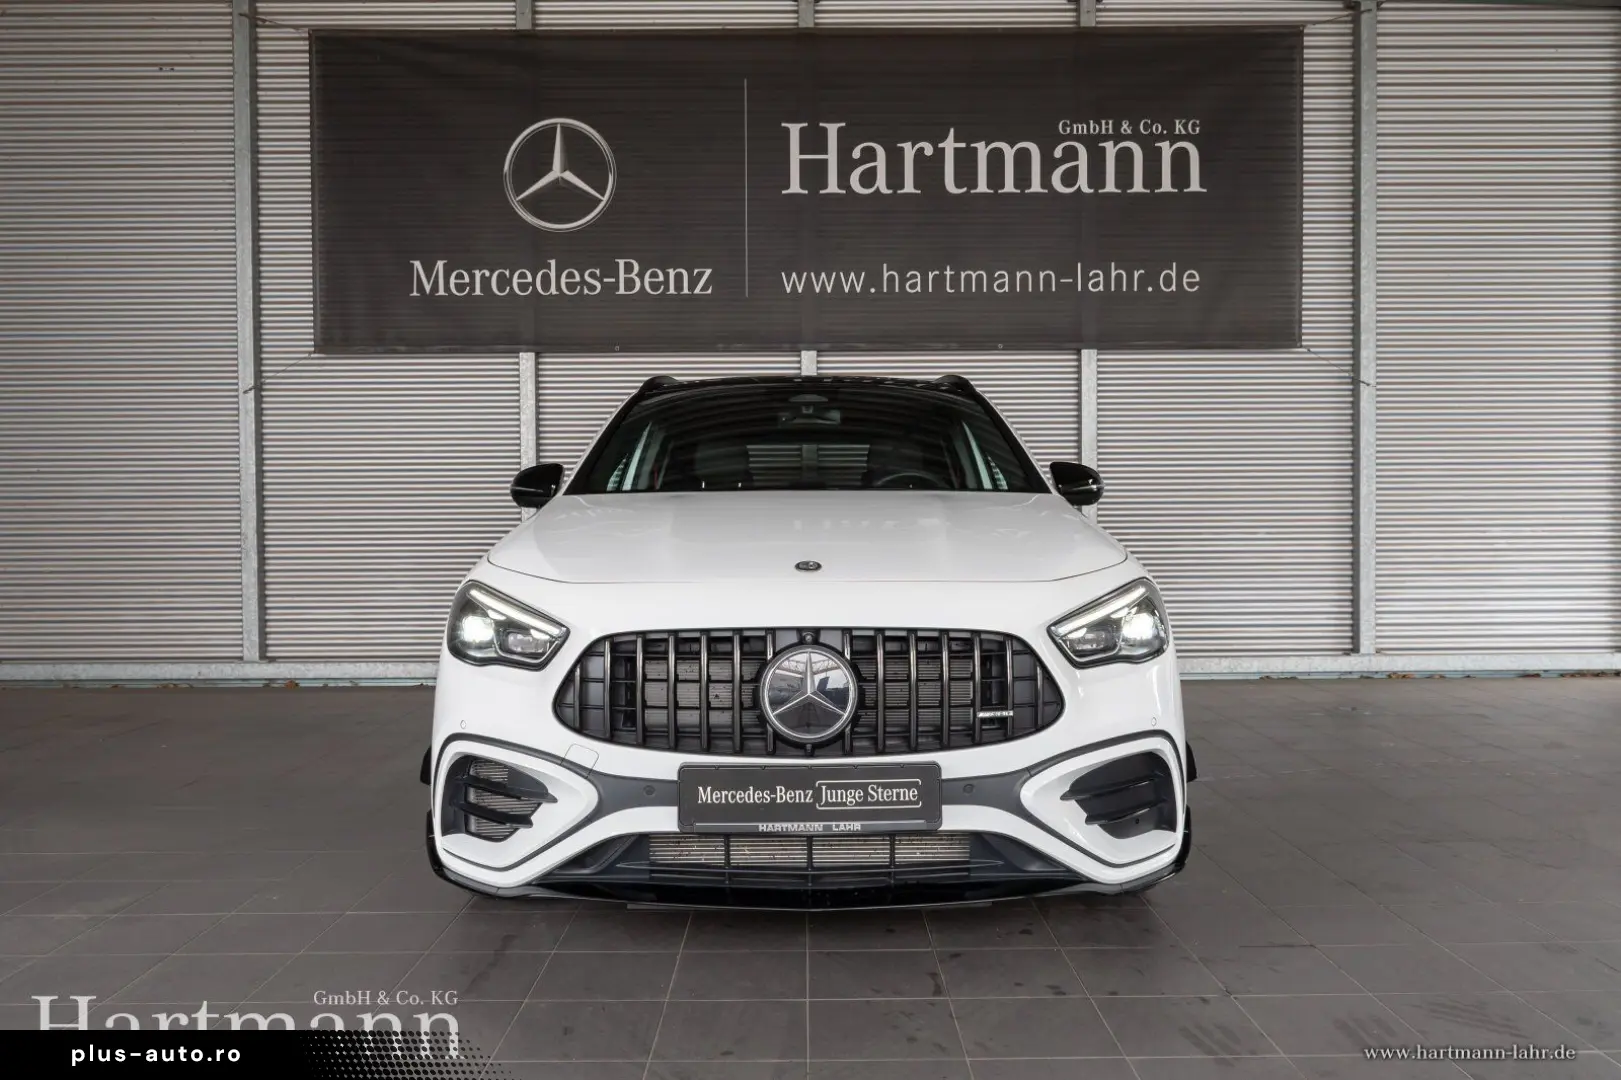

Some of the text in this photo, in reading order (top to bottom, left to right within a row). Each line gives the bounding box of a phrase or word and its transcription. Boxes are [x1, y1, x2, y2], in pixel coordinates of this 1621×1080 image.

[1057, 118, 1202, 135] GmbH & Co. KG
[781, 122, 1208, 195] Hartmann
[409, 258, 713, 297] Mercedes-Benz
[781, 261, 1201, 294] www.hartmann-lahr.de
[697, 784, 919, 806] Mercedes-Benz Junge Sterne
[758, 823, 823, 832] HARTMANN
